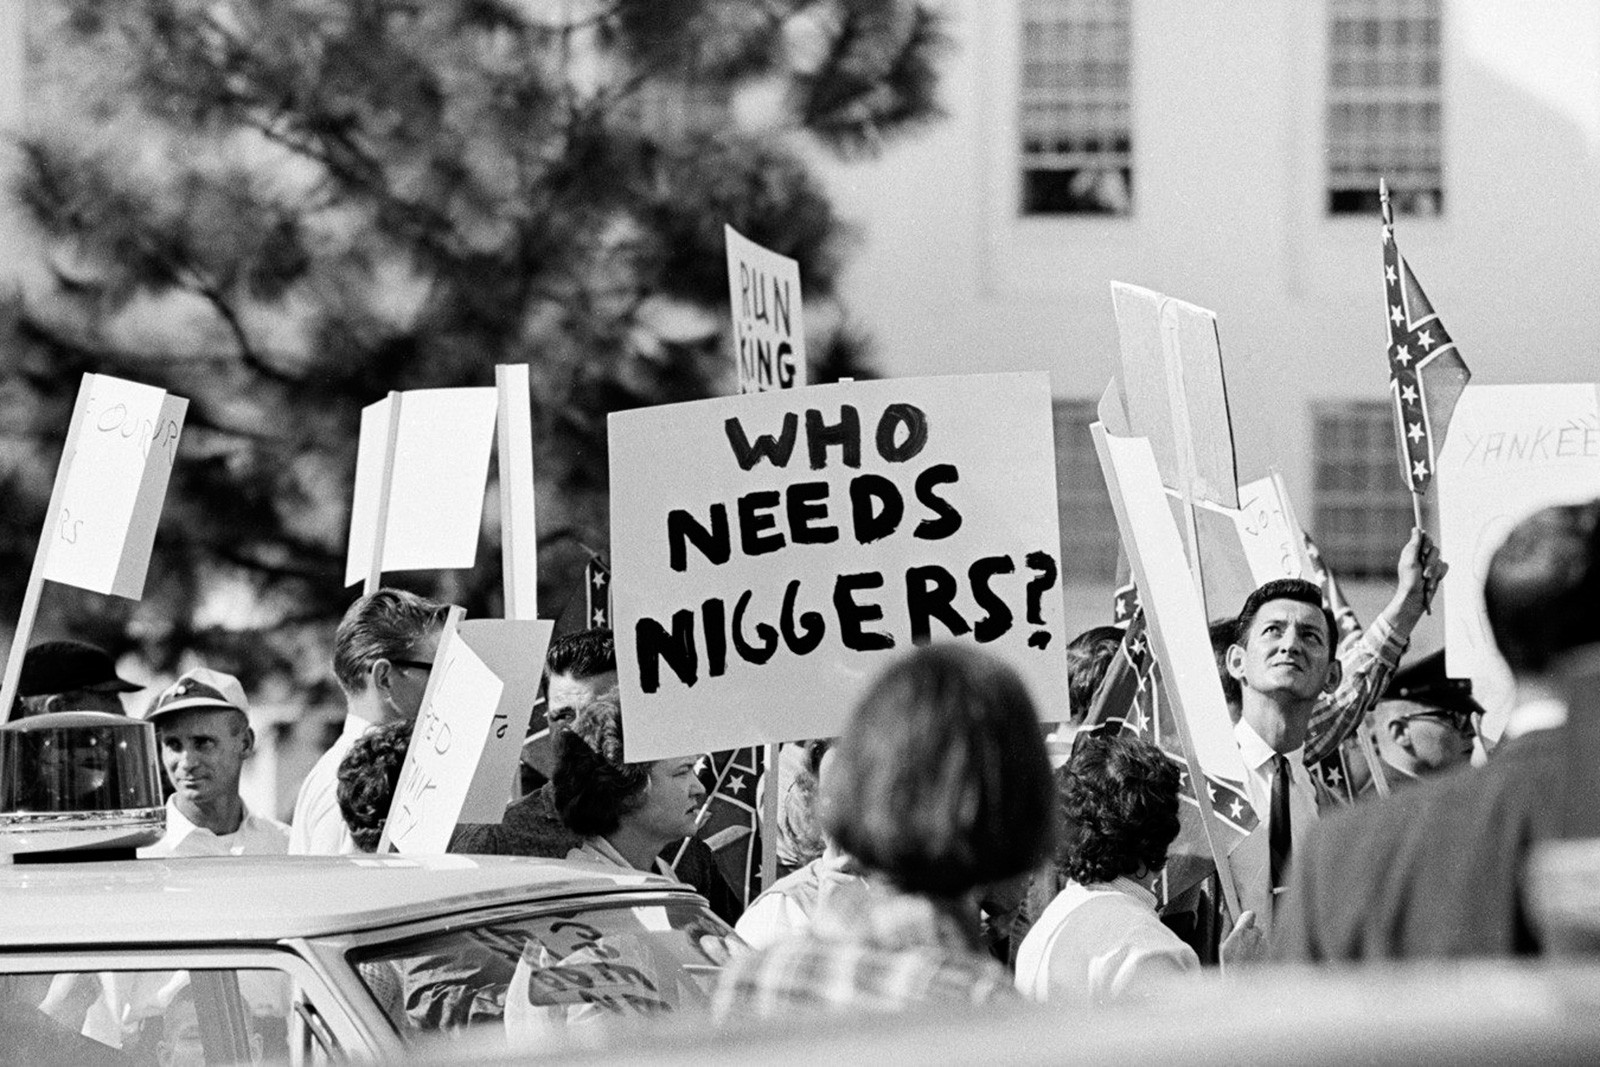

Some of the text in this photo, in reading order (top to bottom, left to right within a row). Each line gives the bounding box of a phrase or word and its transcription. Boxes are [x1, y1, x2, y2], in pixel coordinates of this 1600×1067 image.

[740, 260, 791, 338] RUN
[738, 321, 796, 390] KING
[725, 403, 929, 472] WHO
[667, 464, 963, 573] NEEDS
[634, 550, 1058, 695] NIGGERS?
